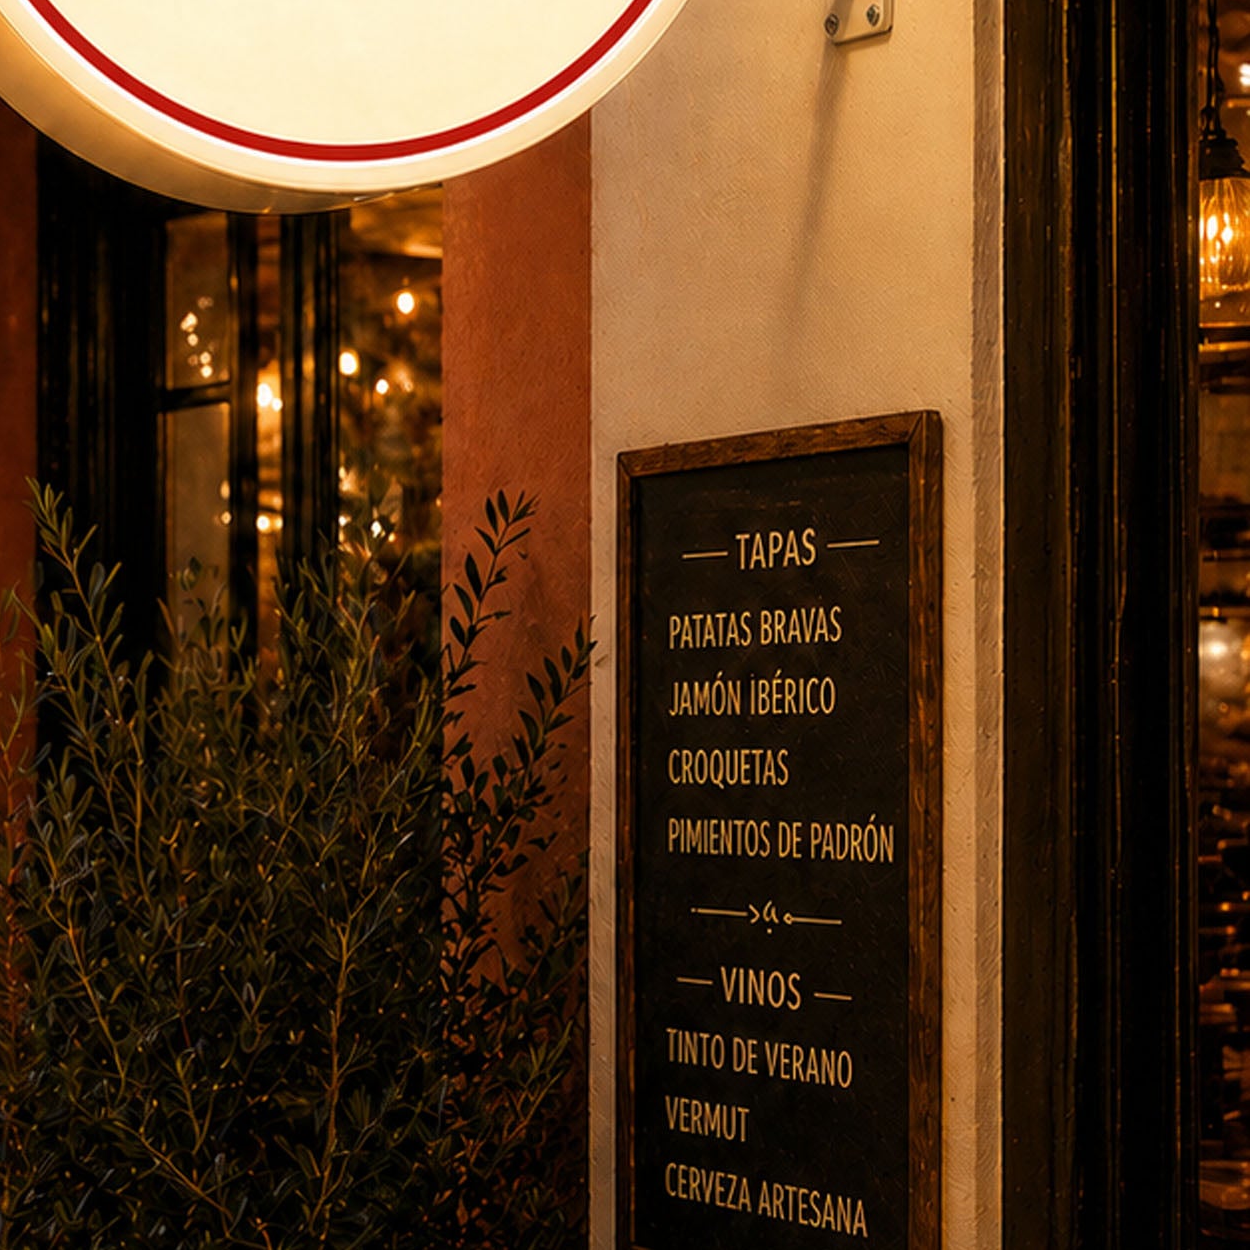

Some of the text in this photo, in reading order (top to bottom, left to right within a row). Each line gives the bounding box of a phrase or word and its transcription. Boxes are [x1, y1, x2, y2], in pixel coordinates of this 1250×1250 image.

[735, 527, 816, 570] TAPAS
[669, 605, 842, 650] PATATAS BRAVAS
[669, 670, 741, 717] JAMÓN
[668, 748, 789, 790] CROQUETAS
[668, 813, 894, 863] PIMIENTOS DE PADRÓN
[720, 966, 801, 1011] VINOS
[666, 1027, 853, 1089] TINTO DE VERANO
[665, 1095, 750, 1142] VERMUT
[666, 1162, 868, 1238] CERVEZA ARTESANA
